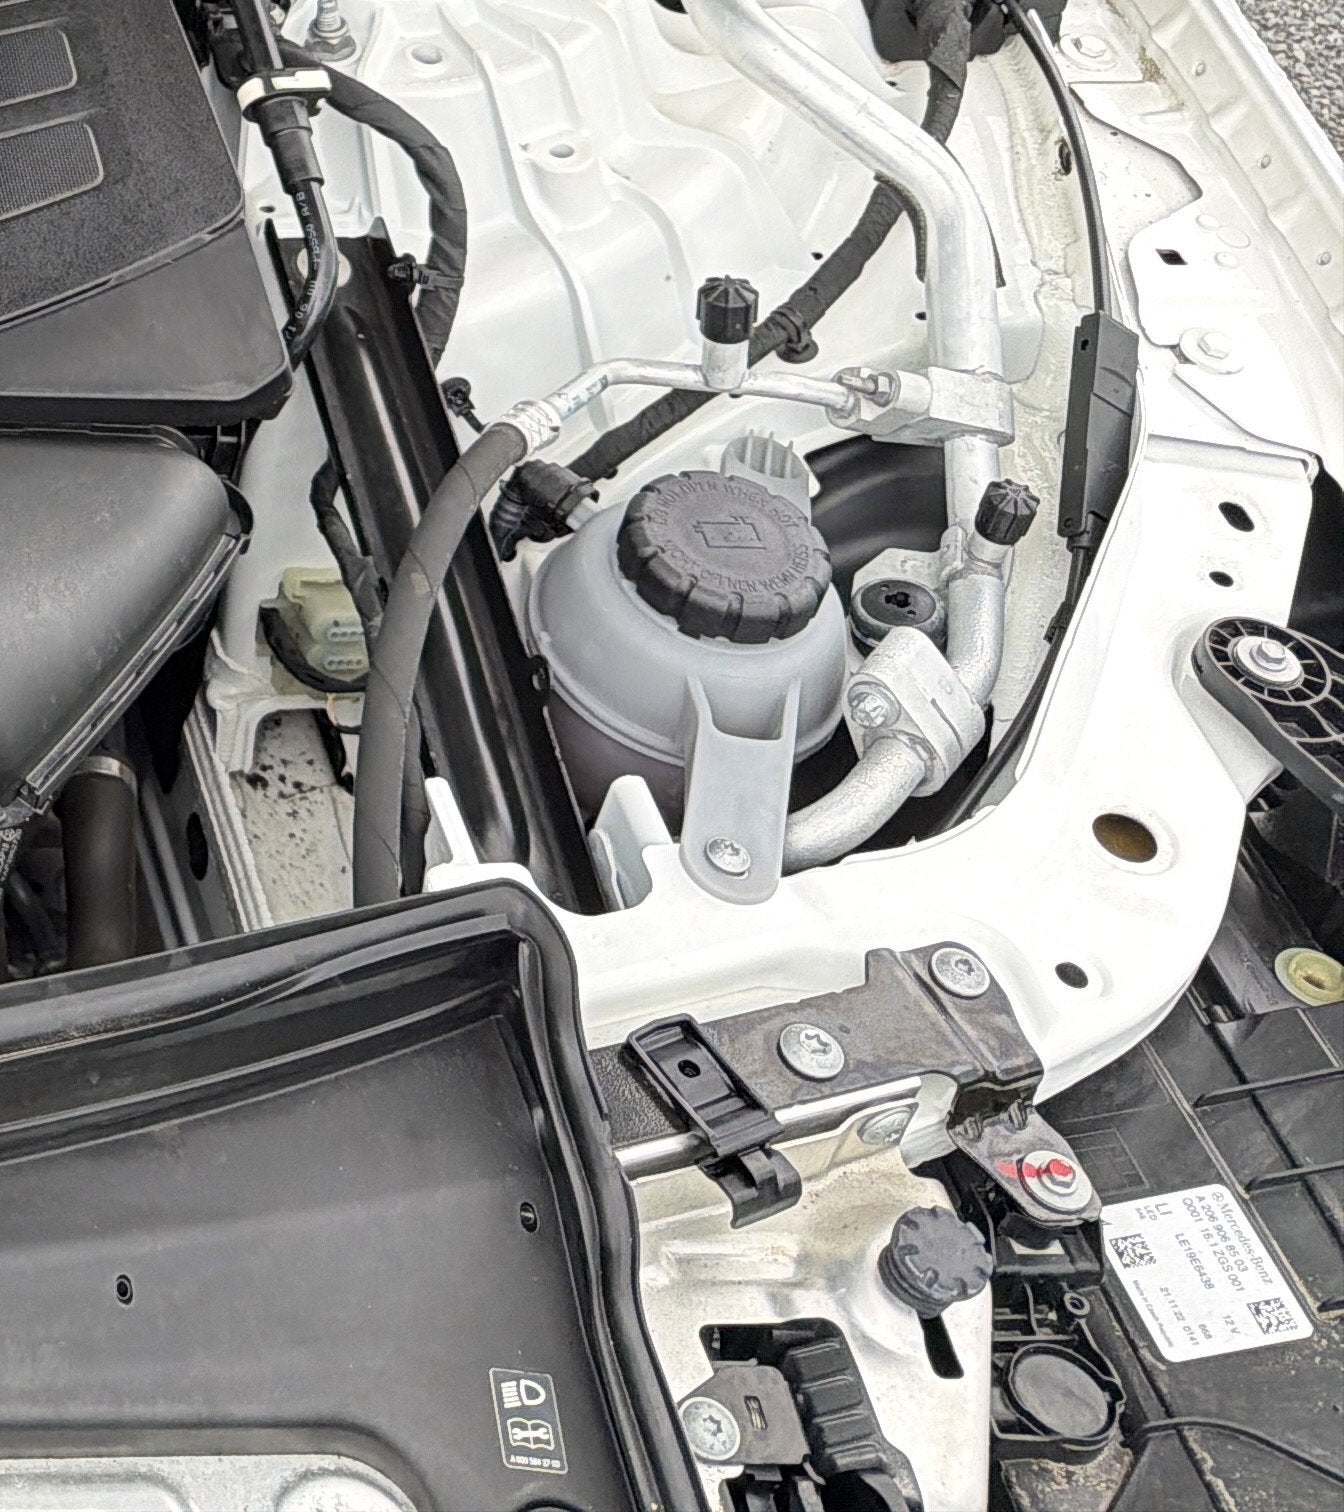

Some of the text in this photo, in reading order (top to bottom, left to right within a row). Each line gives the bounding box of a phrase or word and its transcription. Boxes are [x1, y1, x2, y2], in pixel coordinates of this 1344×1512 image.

[1143, 1205, 1158, 1221] LED
[1180, 1197, 1245, 1291] Q001 16.1 ZGS 001
[1199, 1204, 1219, 1222] 206
[1211, 1224, 1231, 1242] 906
[1233, 1259, 1249, 1272] 03
[1216, 1202, 1275, 1285] Mercedes-Benz
[1222, 1314, 1235, 1326] 12
